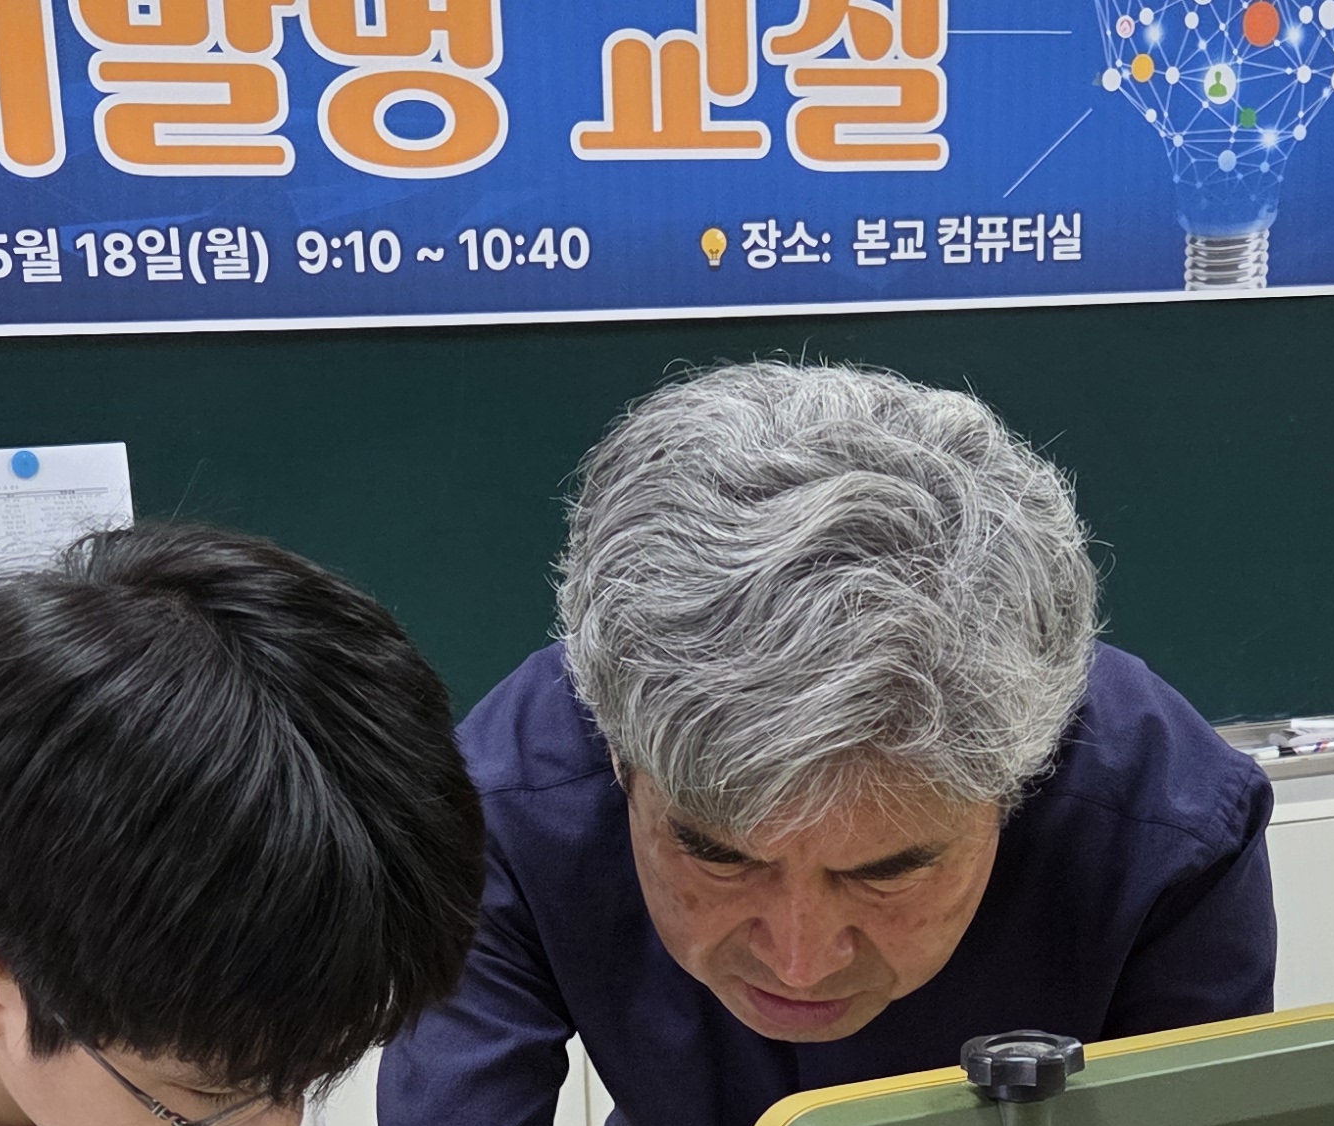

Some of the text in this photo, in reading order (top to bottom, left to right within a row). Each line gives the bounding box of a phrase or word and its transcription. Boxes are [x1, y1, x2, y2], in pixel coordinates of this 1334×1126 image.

[75, 226, 269, 285] 18일(월)
[296, 229, 401, 274] 9:10
[458, 227, 590, 271] 10:40
[741, 212, 1082, 269] 장소: 본교 컴퓨터실
